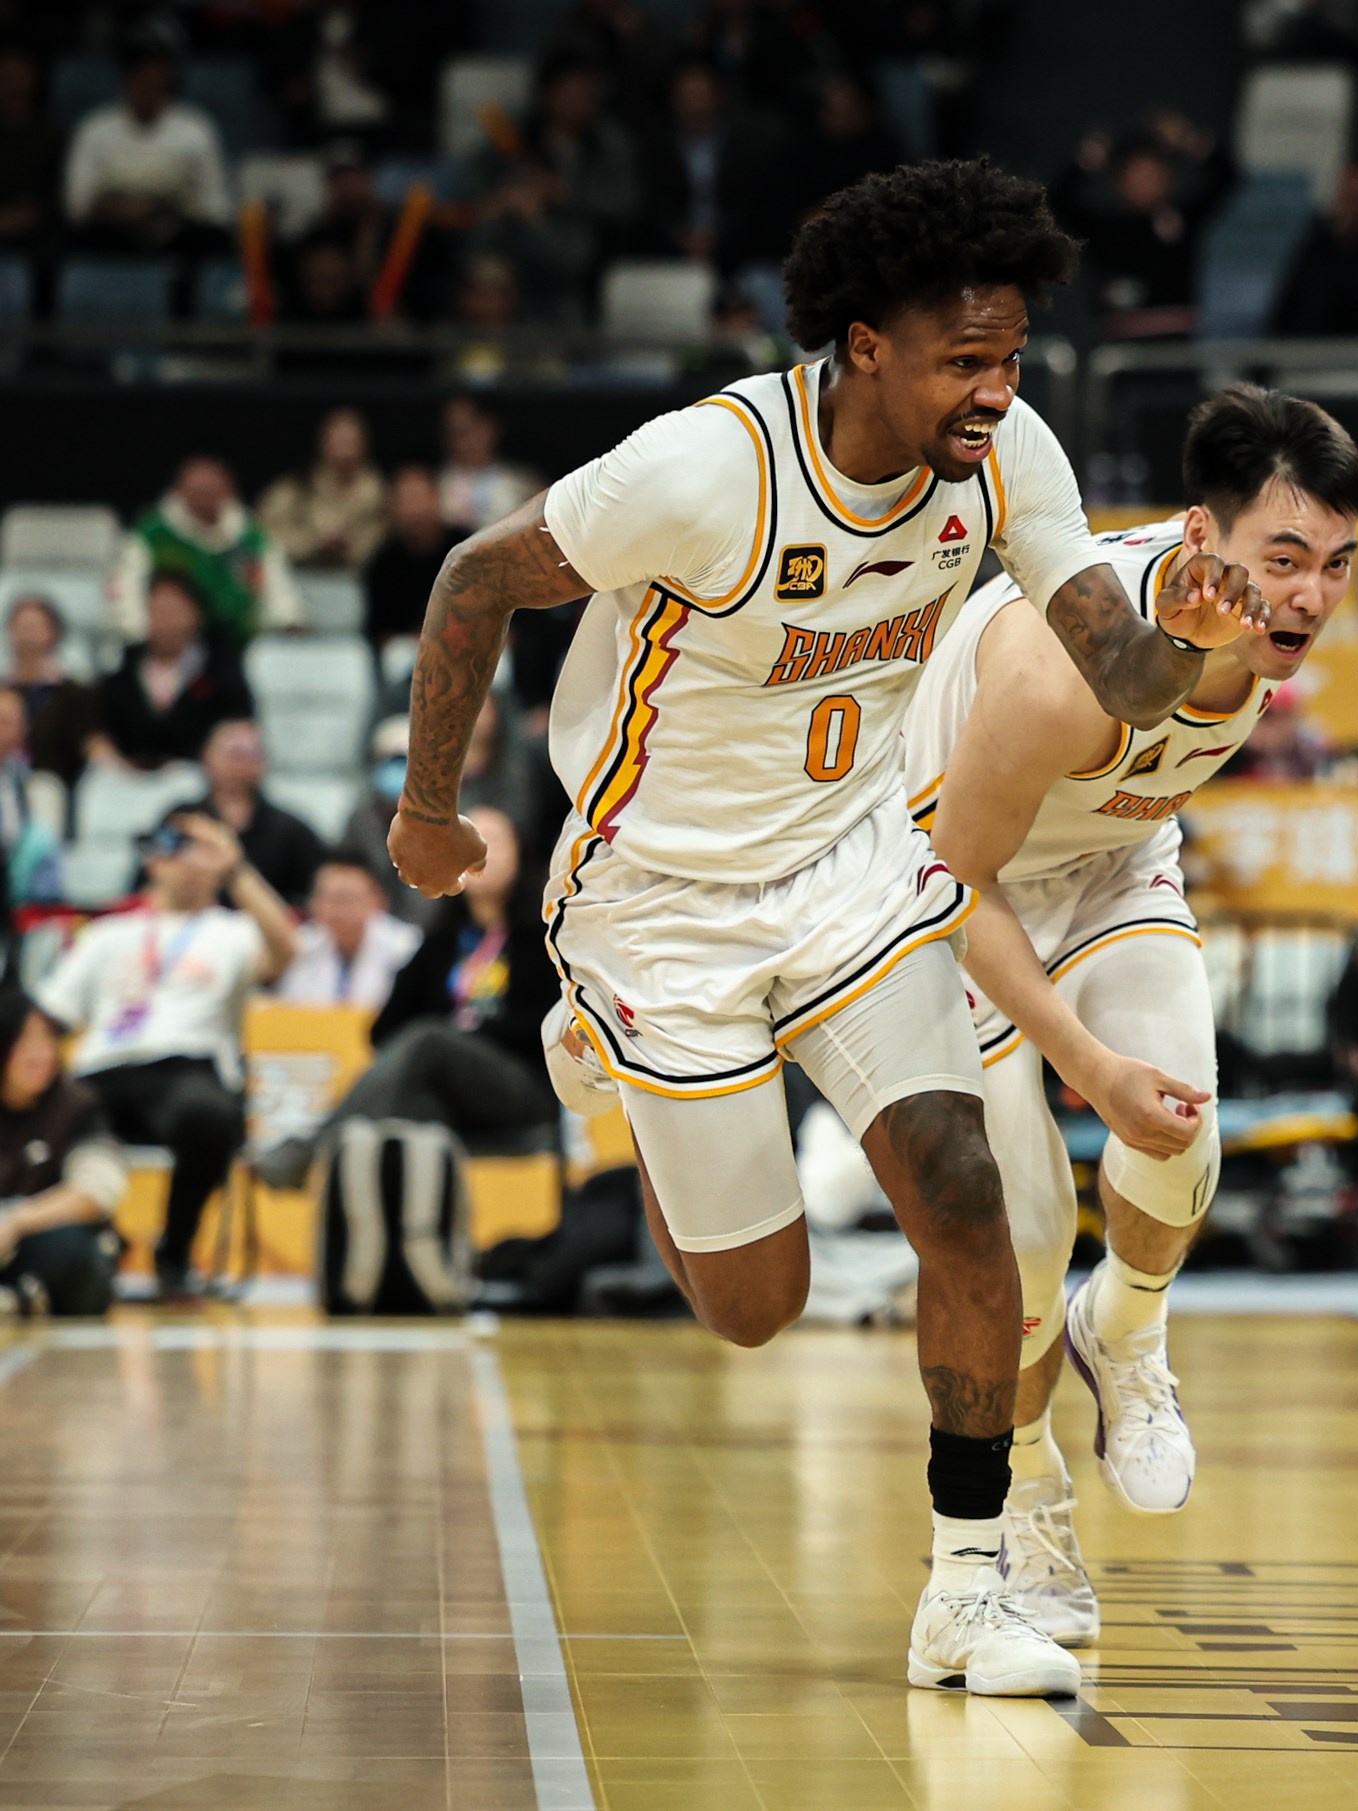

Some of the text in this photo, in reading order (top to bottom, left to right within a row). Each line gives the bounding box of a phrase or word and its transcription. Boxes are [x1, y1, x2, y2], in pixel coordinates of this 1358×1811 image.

[931, 544, 970, 561] 广发银行
[937, 557, 962, 570] CGB
[789, 581, 817, 591] CBA
[761, 580, 959, 687] SHANXI
[803, 694, 862, 782] 0
